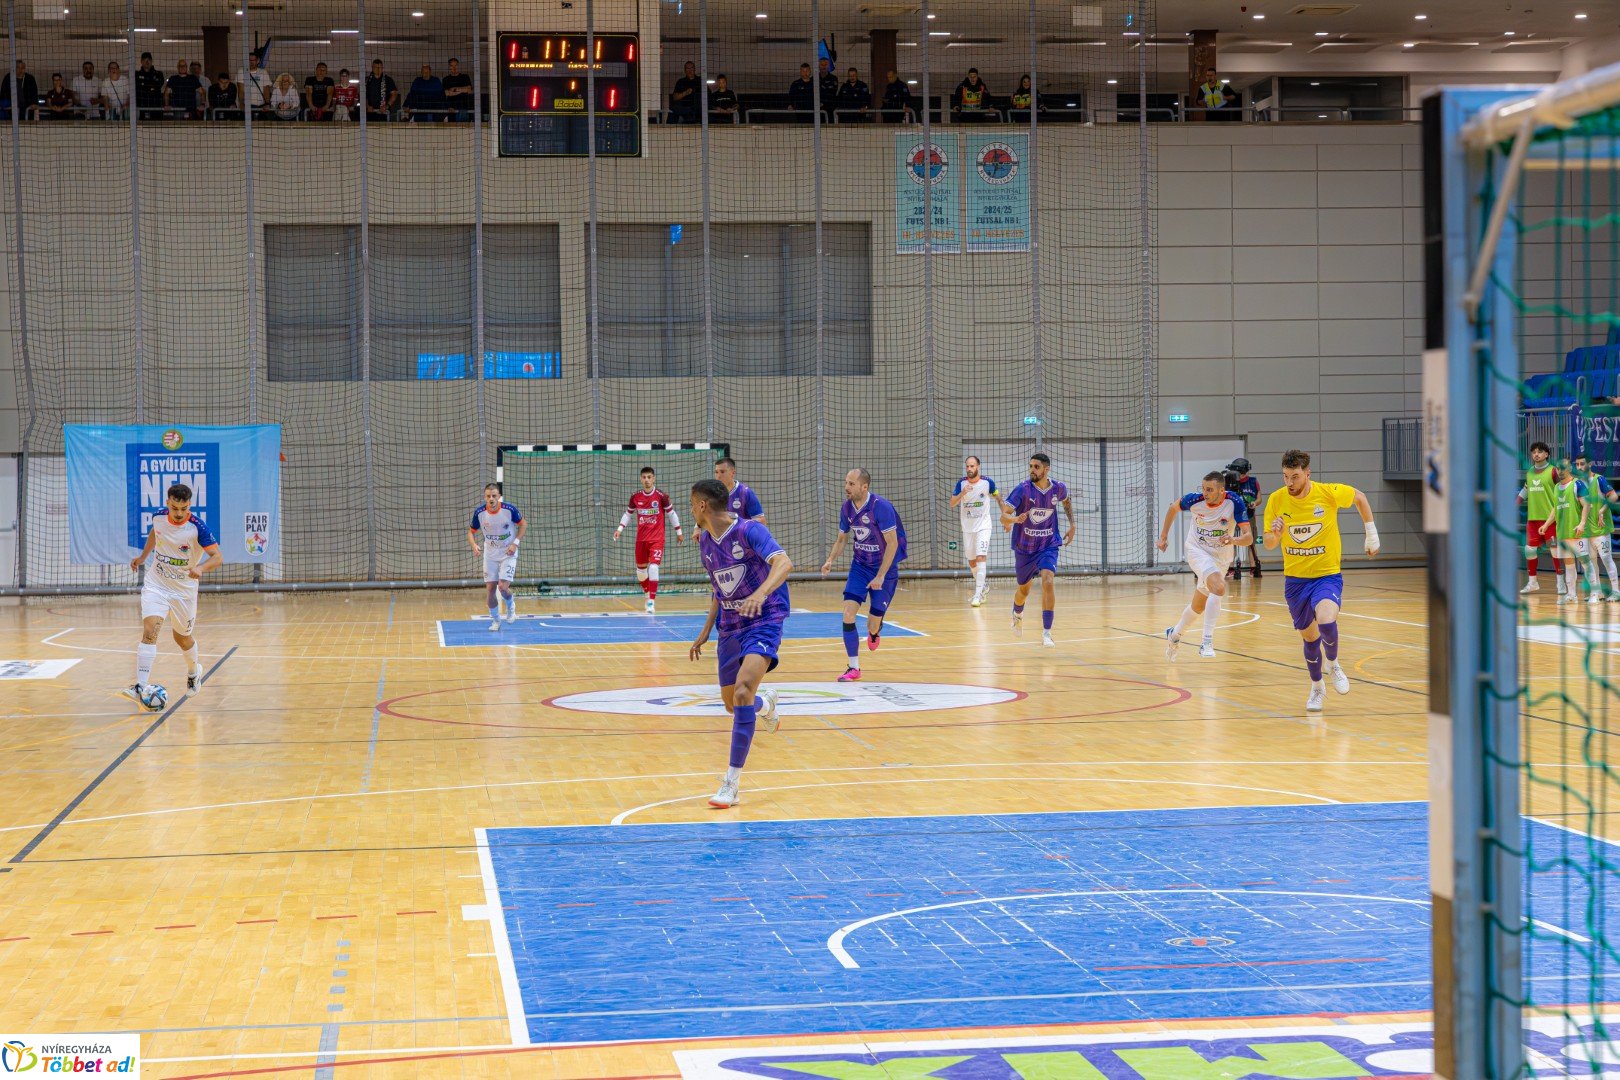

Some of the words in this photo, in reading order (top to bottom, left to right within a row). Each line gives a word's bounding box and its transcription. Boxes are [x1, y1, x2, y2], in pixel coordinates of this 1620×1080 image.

[914, 206, 943, 215] 202/24
[906, 217, 934, 225] FUTSL
[976, 216, 1003, 224] FUTSAL
[140, 459, 148, 472] A
[151, 457, 206, 472] GYŰLÖLET
[140, 474, 207, 507] NEM
[245, 515, 267, 524] FAIR
[246, 523, 267, 532] PLAY
[1293, 526, 1311, 535] MOL
[653, 549, 662, 558] 22
[718, 572, 735, 584] MOL
[723, 600, 745, 609] TIPP
